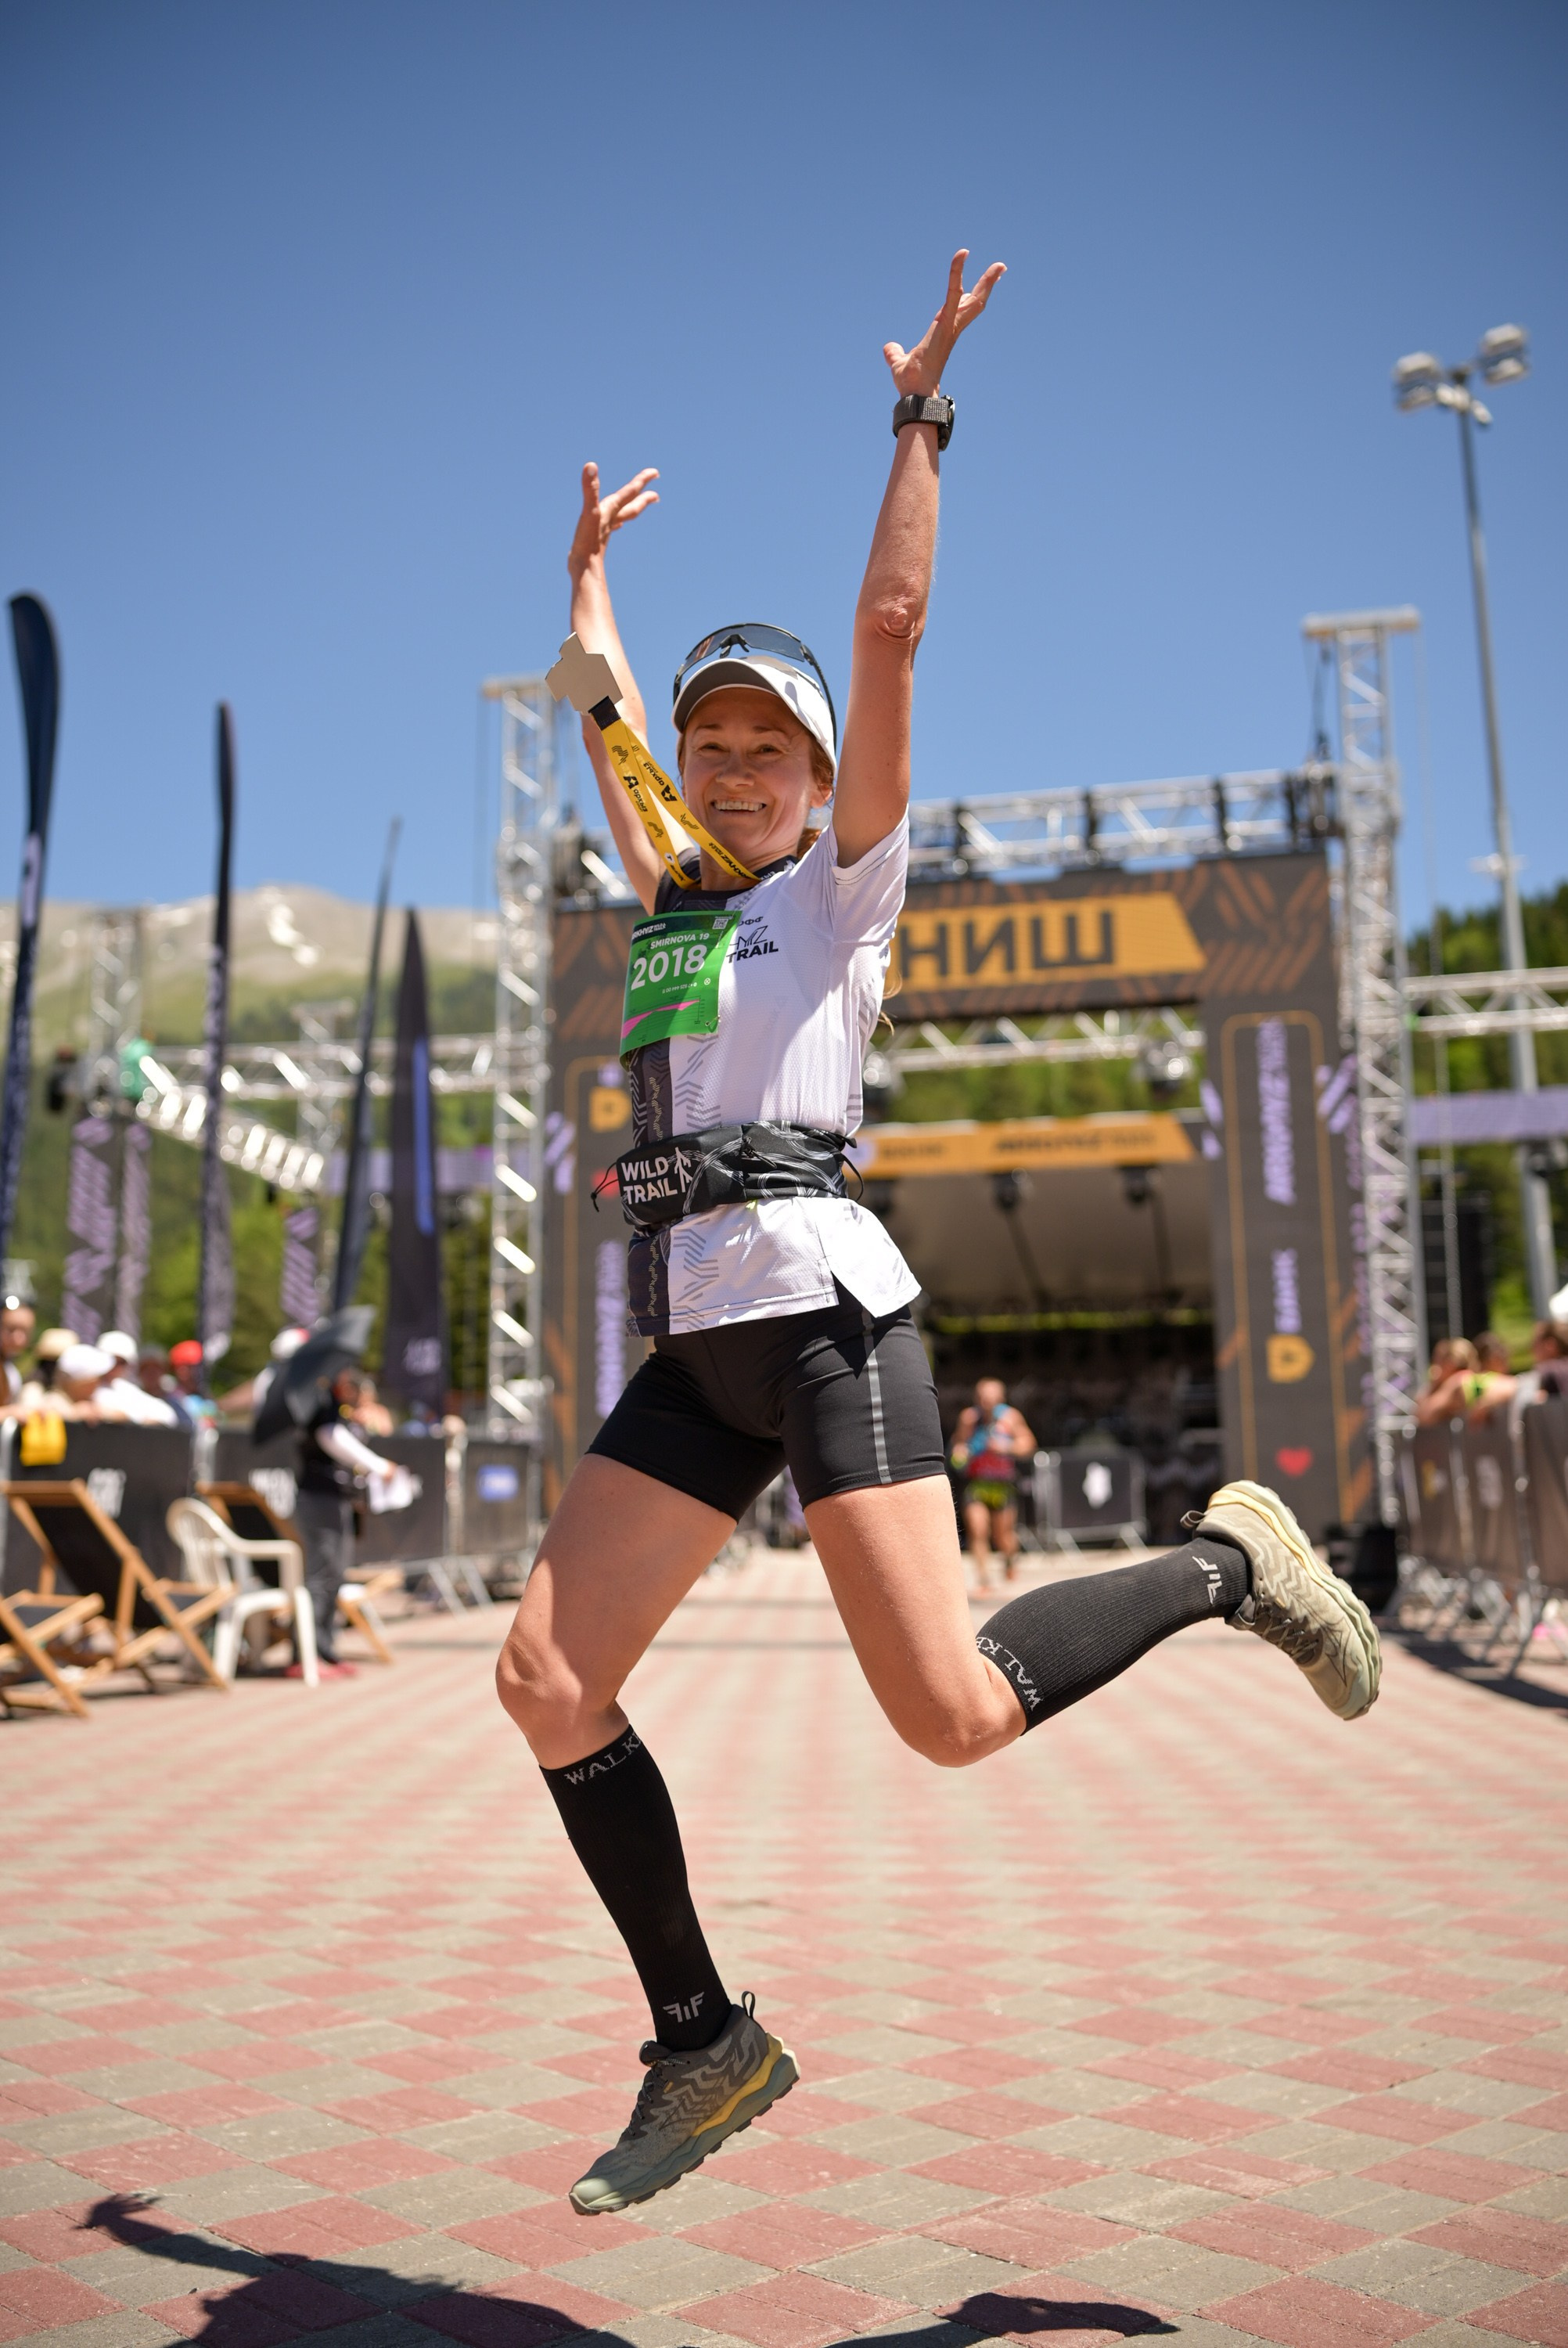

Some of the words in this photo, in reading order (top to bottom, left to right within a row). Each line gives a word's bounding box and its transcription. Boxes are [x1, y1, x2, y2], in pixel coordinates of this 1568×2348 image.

[650, 935, 696, 949] SMIRNOVA
[726, 941, 779, 963] TRAIL
[900, 910, 1114, 979] НИШ
[631, 944, 707, 991] 2018
[621, 1156, 669, 1182] WILD
[623, 1177, 678, 1205] TRAIL
